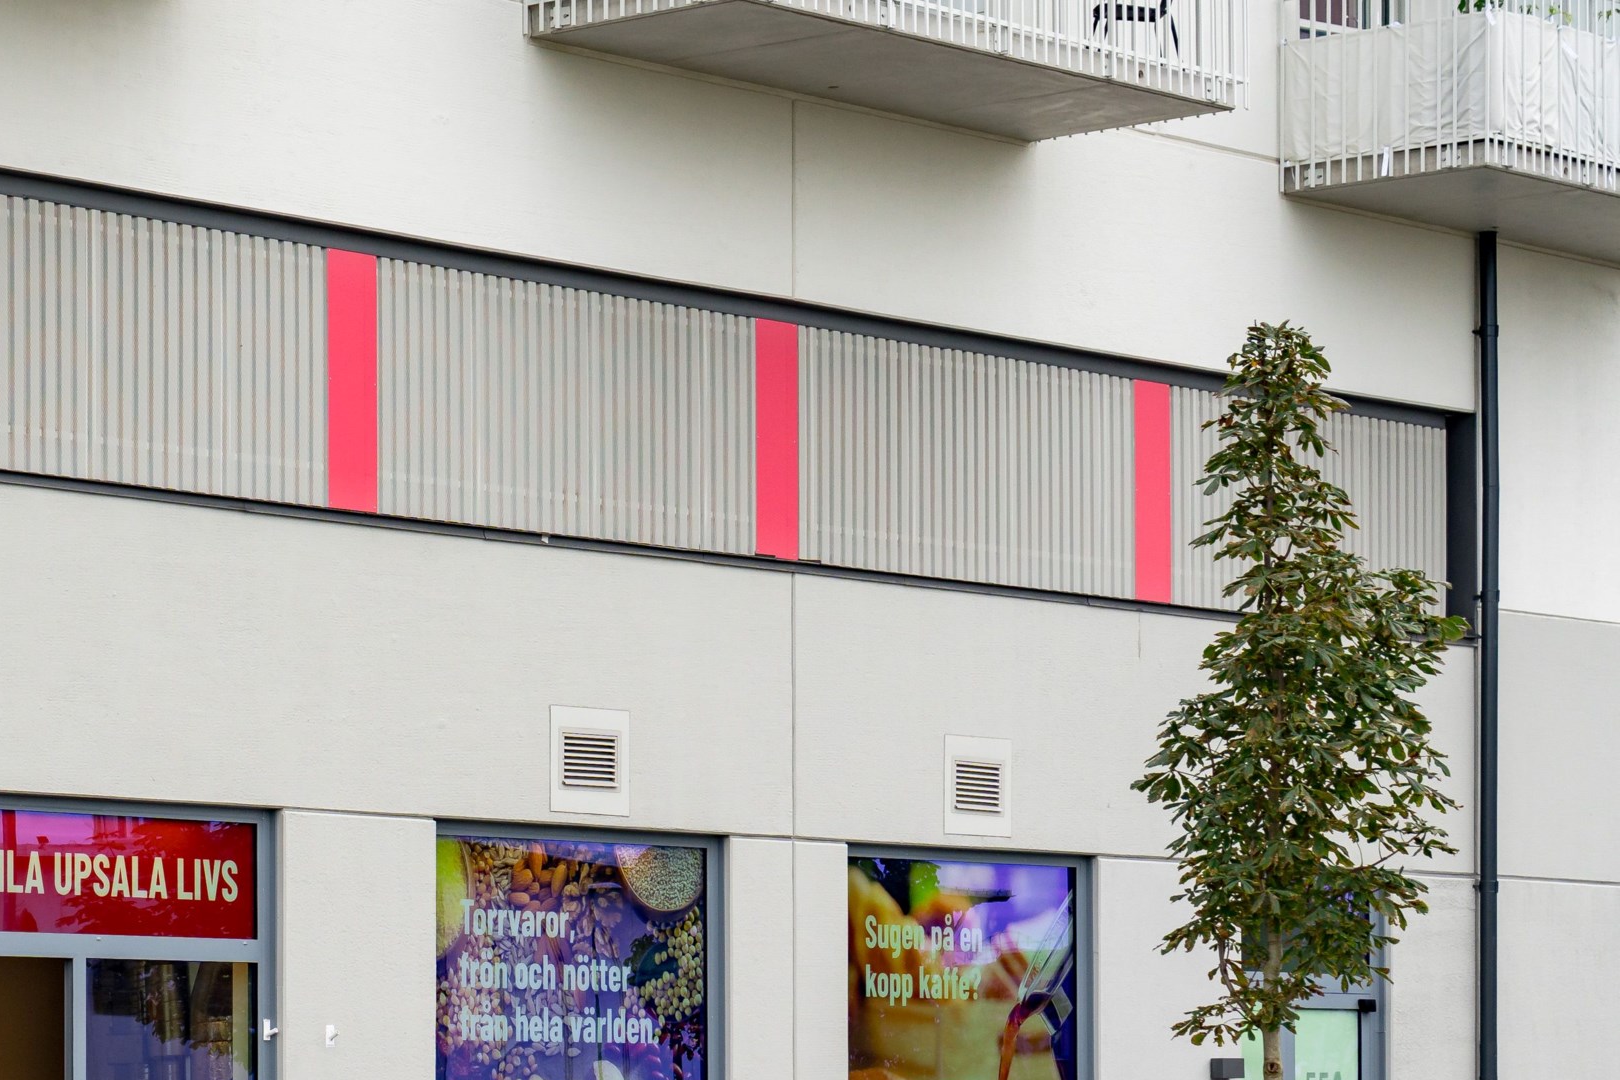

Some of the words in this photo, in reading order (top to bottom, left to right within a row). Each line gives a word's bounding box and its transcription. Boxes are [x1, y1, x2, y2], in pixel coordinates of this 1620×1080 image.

[54, 852, 168, 900] UPSALA
[177, 857, 239, 903] LIVS
[460, 898, 576, 944] Torrvaror,
[865, 914, 925, 959] Sugen
[931, 913, 955, 961] på
[960, 926, 983, 953] en
[460, 947, 508, 989] frön
[514, 954, 556, 990] och
[563, 955, 631, 992] nötter
[865, 964, 914, 1007] kopp
[919, 965, 982, 1001] kaffe?
[460, 999, 508, 1042] från
[515, 1006, 564, 1043] hela
[570, 1006, 660, 1044] världen.
